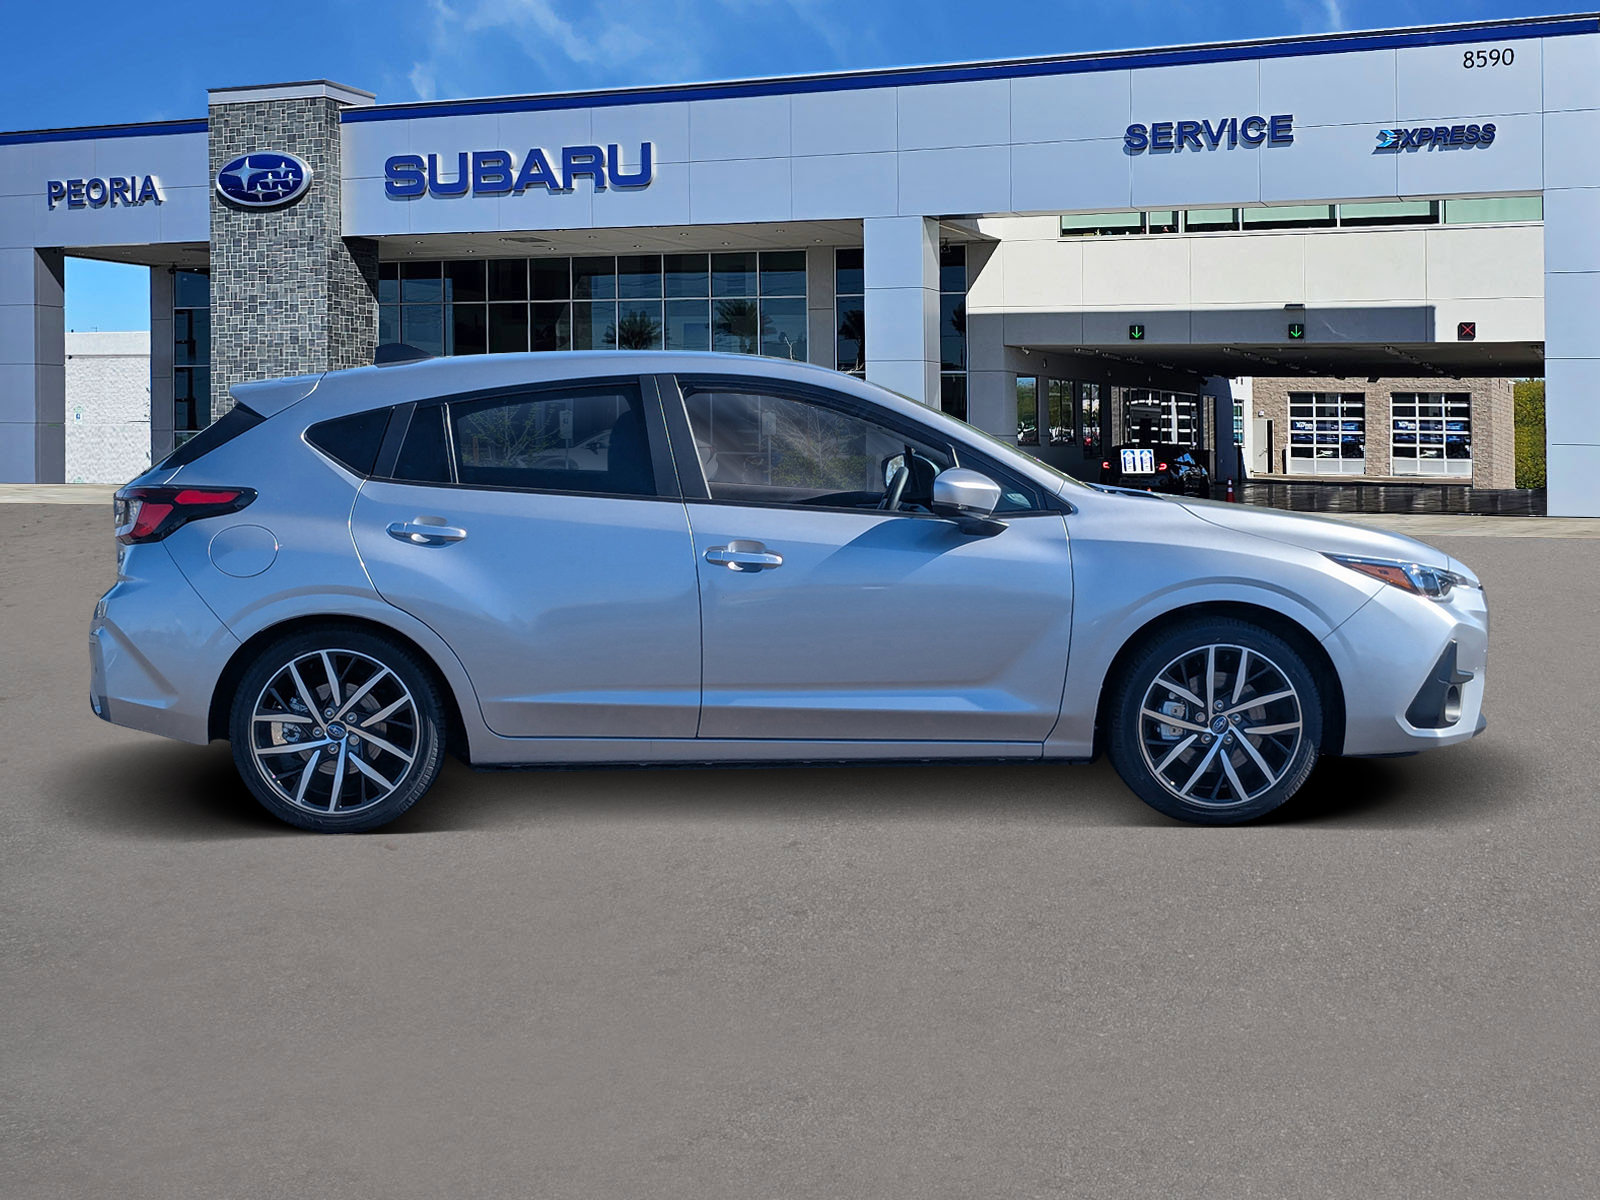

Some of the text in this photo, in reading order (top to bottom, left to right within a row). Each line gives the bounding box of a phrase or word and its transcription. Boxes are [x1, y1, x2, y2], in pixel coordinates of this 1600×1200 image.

[1463, 48, 1515, 69] 8590
[1125, 114, 1295, 151] SERVICE
[1375, 123, 1497, 149] EXPRESS
[384, 141, 653, 198] SUBARU
[47, 175, 163, 209] PEORIA
